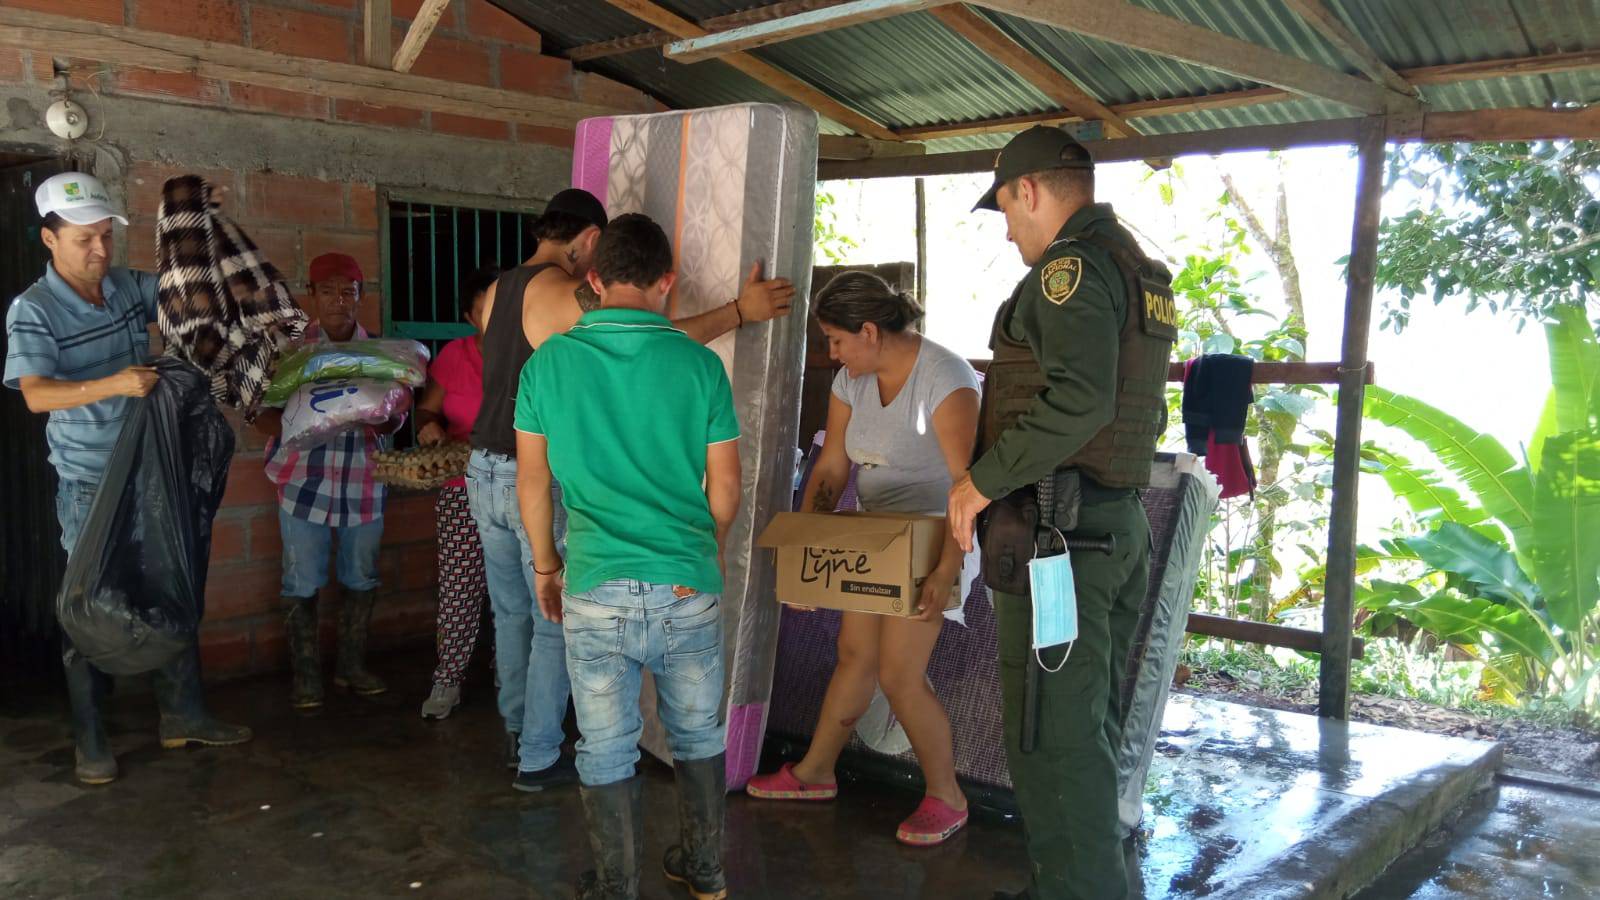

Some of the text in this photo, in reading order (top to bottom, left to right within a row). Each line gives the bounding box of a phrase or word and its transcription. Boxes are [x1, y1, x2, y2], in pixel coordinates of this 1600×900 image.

[1144, 290, 1175, 327] POLIC
[801, 547, 871, 589] Lyne
[849, 583, 861, 592] Sin
